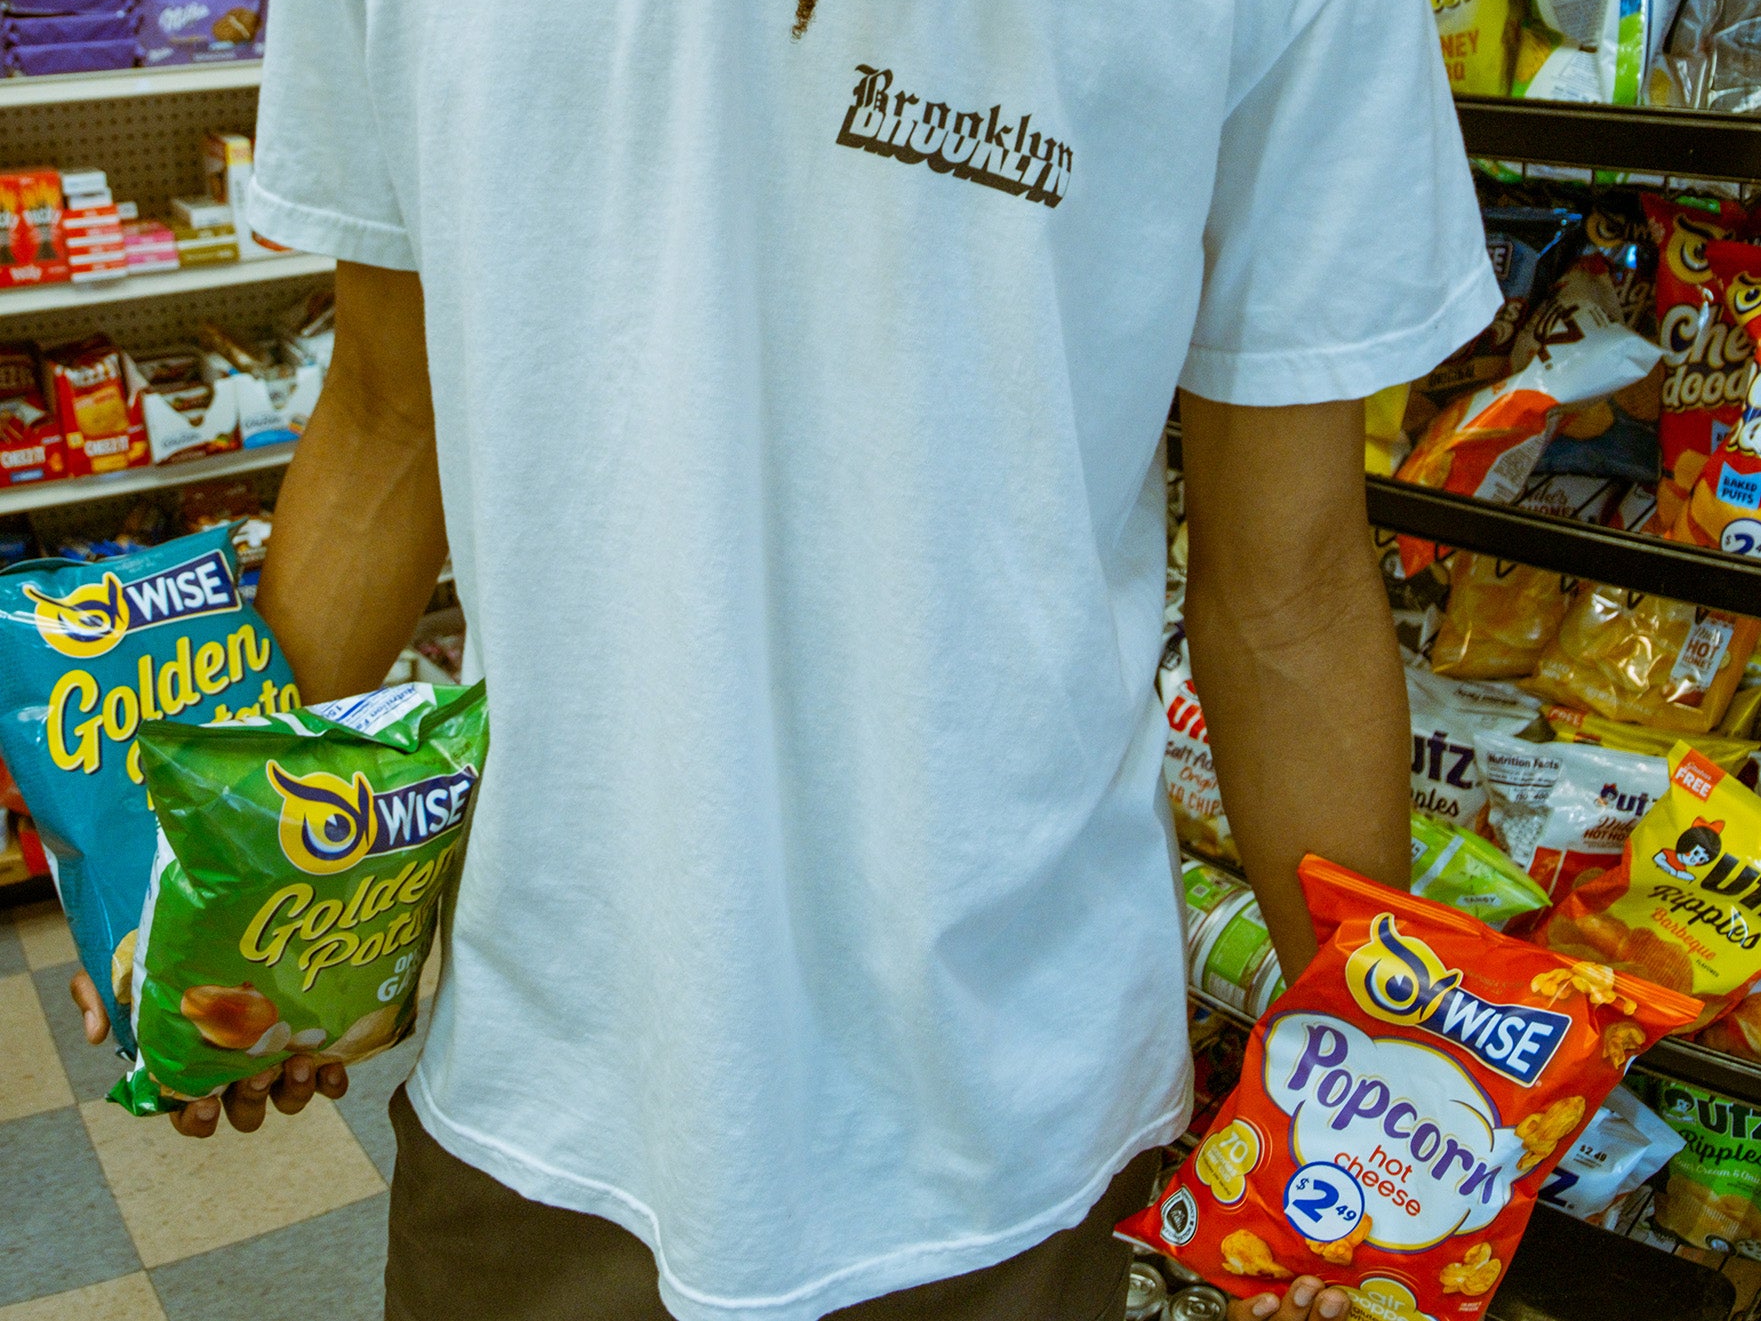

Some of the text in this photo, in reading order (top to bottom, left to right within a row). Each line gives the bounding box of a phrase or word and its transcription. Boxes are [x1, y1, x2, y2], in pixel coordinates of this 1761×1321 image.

[1660, 304, 1753, 367] Che
[1662, 365, 1750, 411] dood
[1721, 487, 1755, 505] PUFFS
[1723, 476, 1758, 493] BAKED
[126, 561, 231, 622] WISE
[1686, 641, 1722, 660] HOT
[47, 624, 271, 775] Golden
[1488, 753, 1561, 771] Nutrition Facts
[1674, 767, 1713, 798] FREE
[378, 780, 471, 846] WISE
[1187, 792, 1225, 817] CHIP
[1648, 884, 1761, 950] Ripples
[1652, 906, 1717, 962] Barbeque
[1443, 991, 1554, 1074] WISE
[1287, 1023, 1503, 1205] Popcorn
[1218, 1130, 1249, 1164] 70
[1368, 1144, 1413, 1184] hot
[1333, 1152, 1422, 1217] cheese
[1367, 1291, 1407, 1311] air
